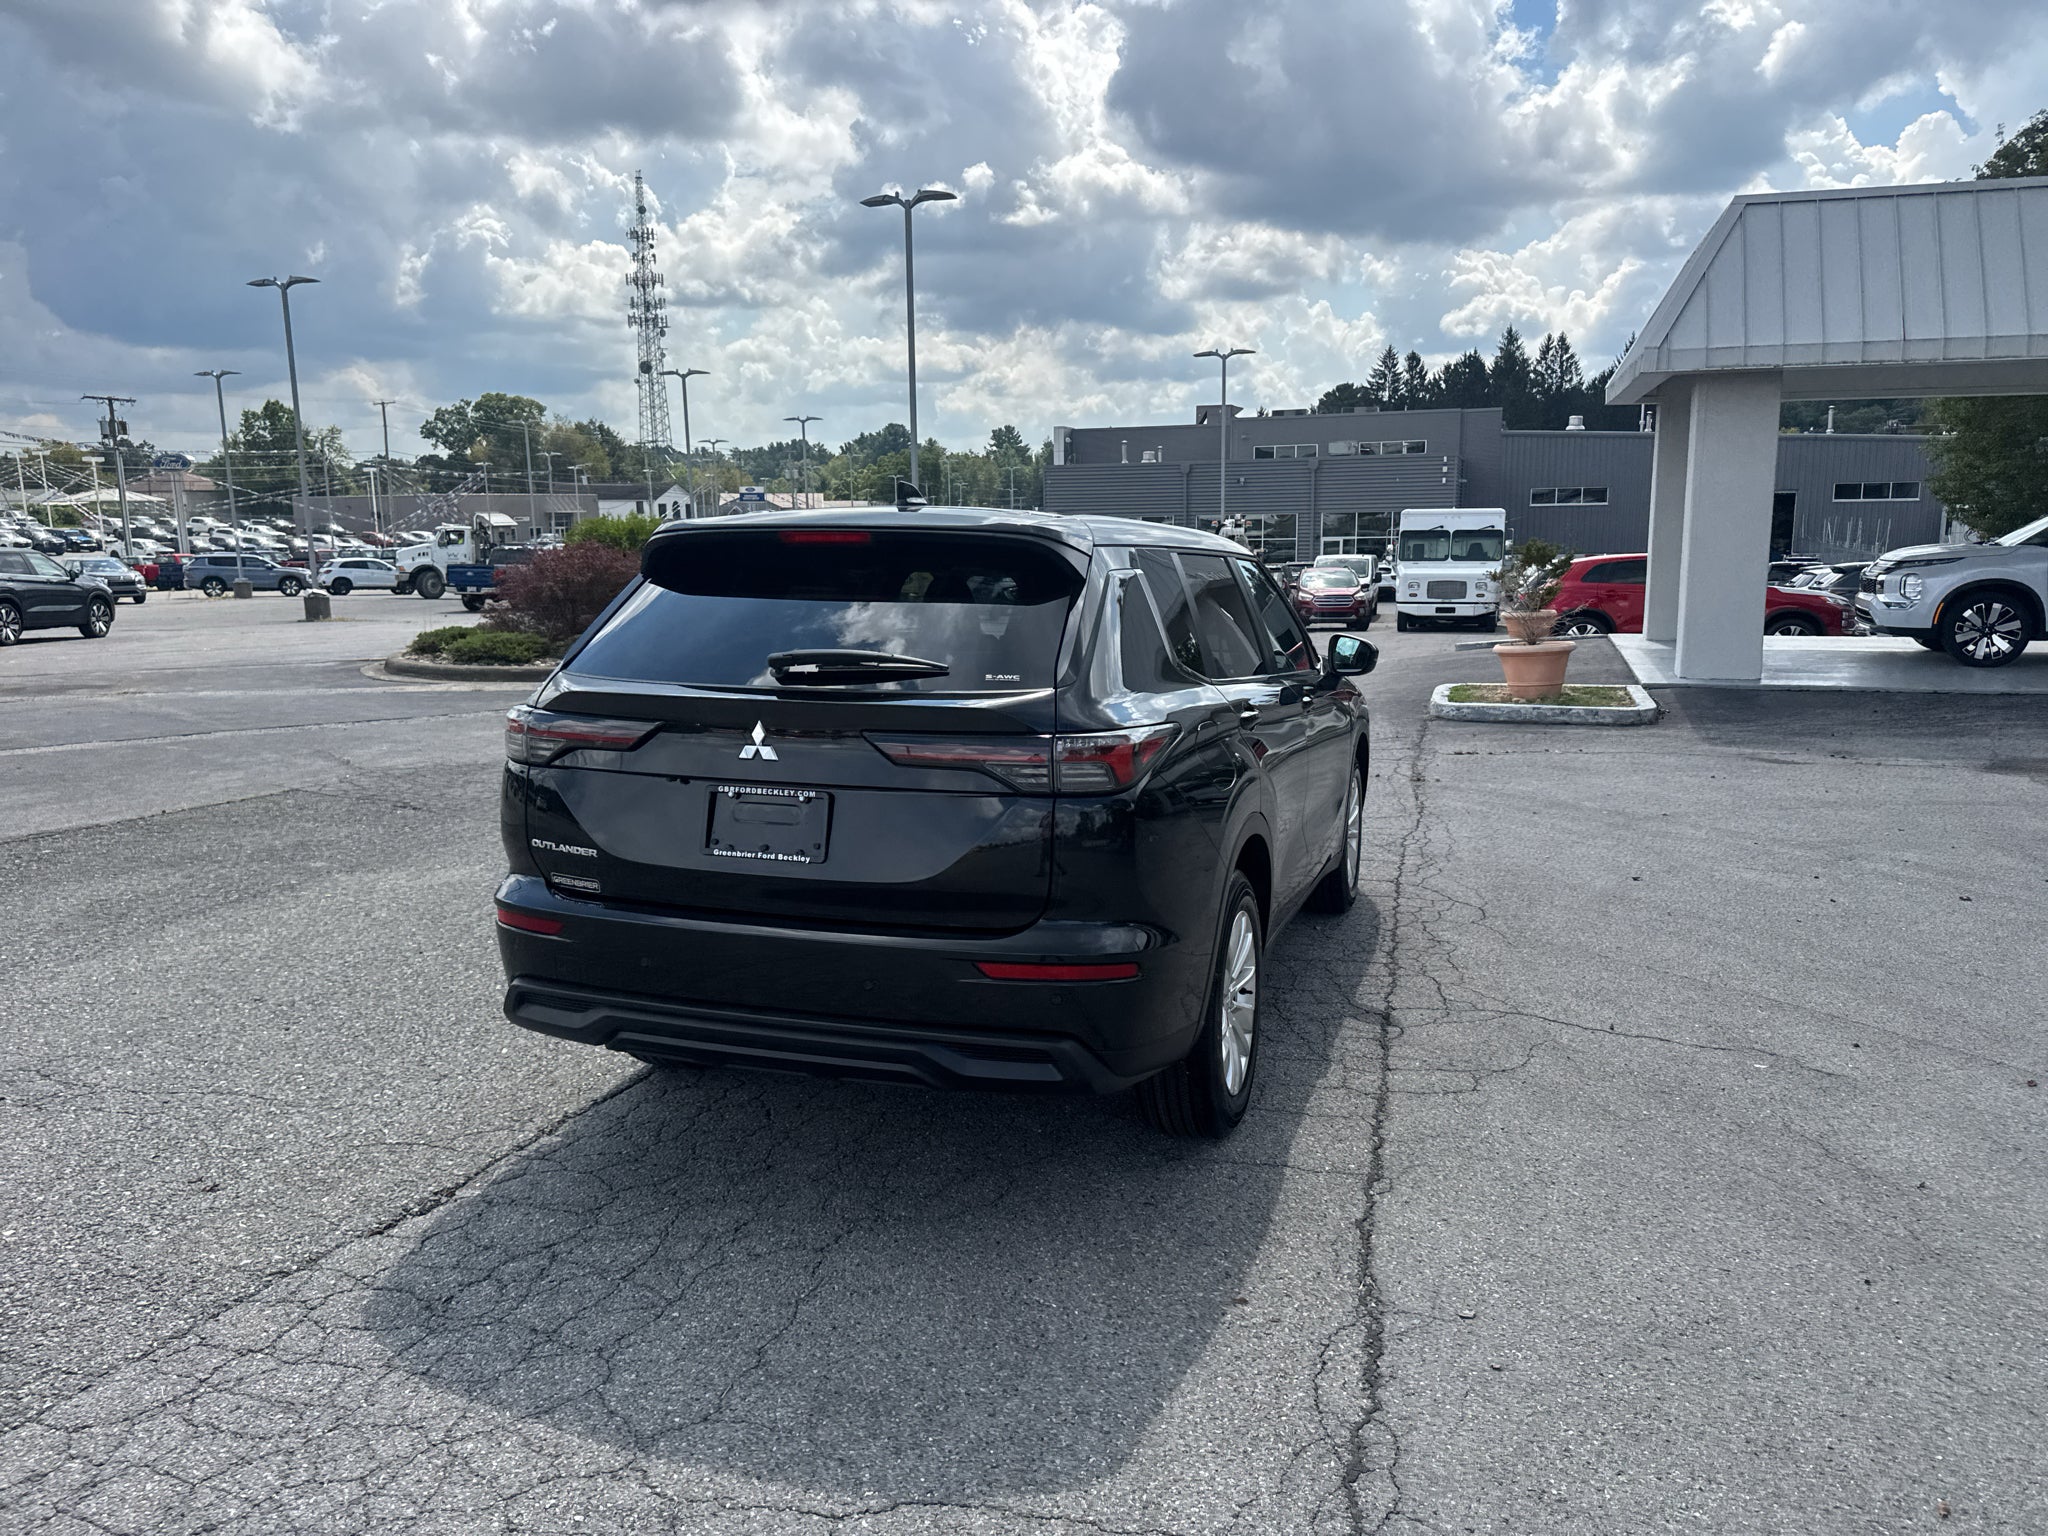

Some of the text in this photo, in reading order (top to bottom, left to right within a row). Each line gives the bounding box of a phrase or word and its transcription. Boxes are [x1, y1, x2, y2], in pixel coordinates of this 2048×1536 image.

[160, 456, 183, 469] Ford
[718, 785, 816, 798] GBRFORDBECKLEY.COM
[531, 838, 598, 857] OUTLANDER
[713, 849, 810, 863] Greenbrier Ford Beckley
